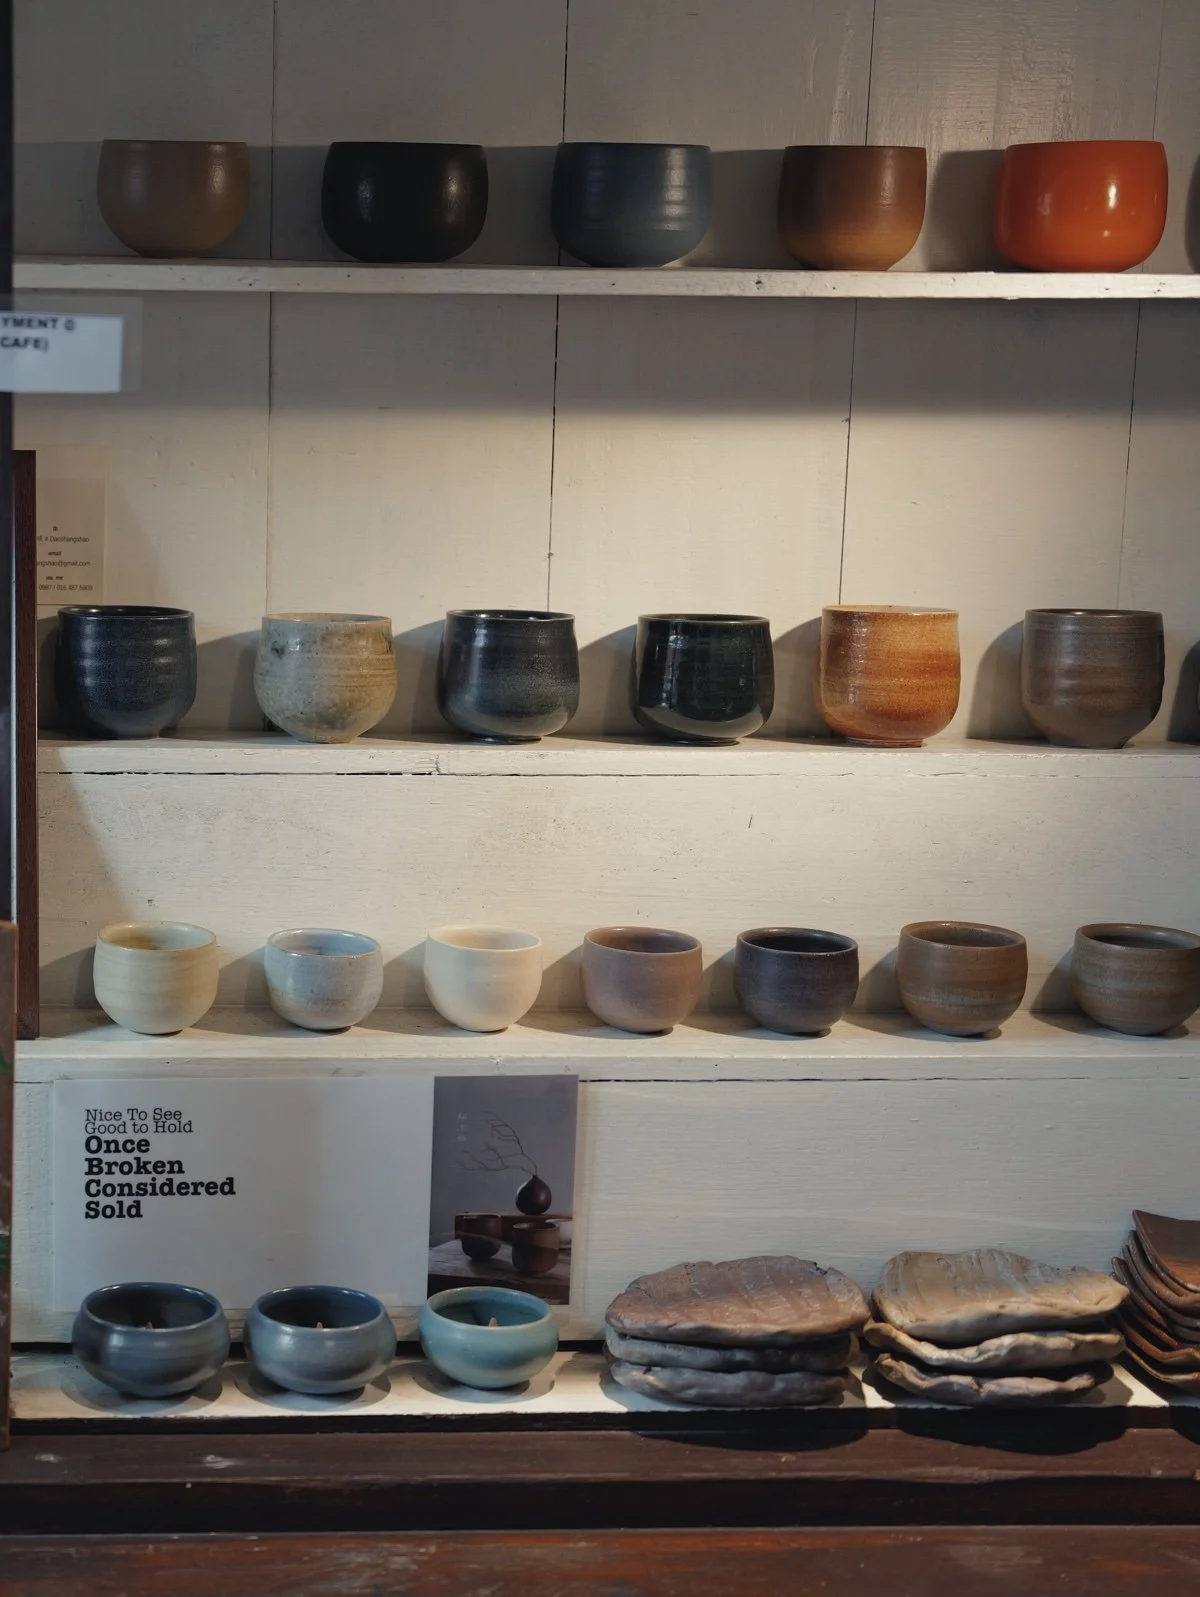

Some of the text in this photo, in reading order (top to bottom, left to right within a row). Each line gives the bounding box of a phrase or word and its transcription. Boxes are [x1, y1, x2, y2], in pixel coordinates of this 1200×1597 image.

[0, 336, 49, 353] CAFE)
[85, 1107, 182, 1122] Nice To See
[85, 1120, 193, 1135] Good to Hold
[84, 1135, 151, 1154] Once
[84, 1157, 185, 1176] Broken
[84, 1177, 236, 1198] Considered
[84, 1200, 143, 1219] Sold
